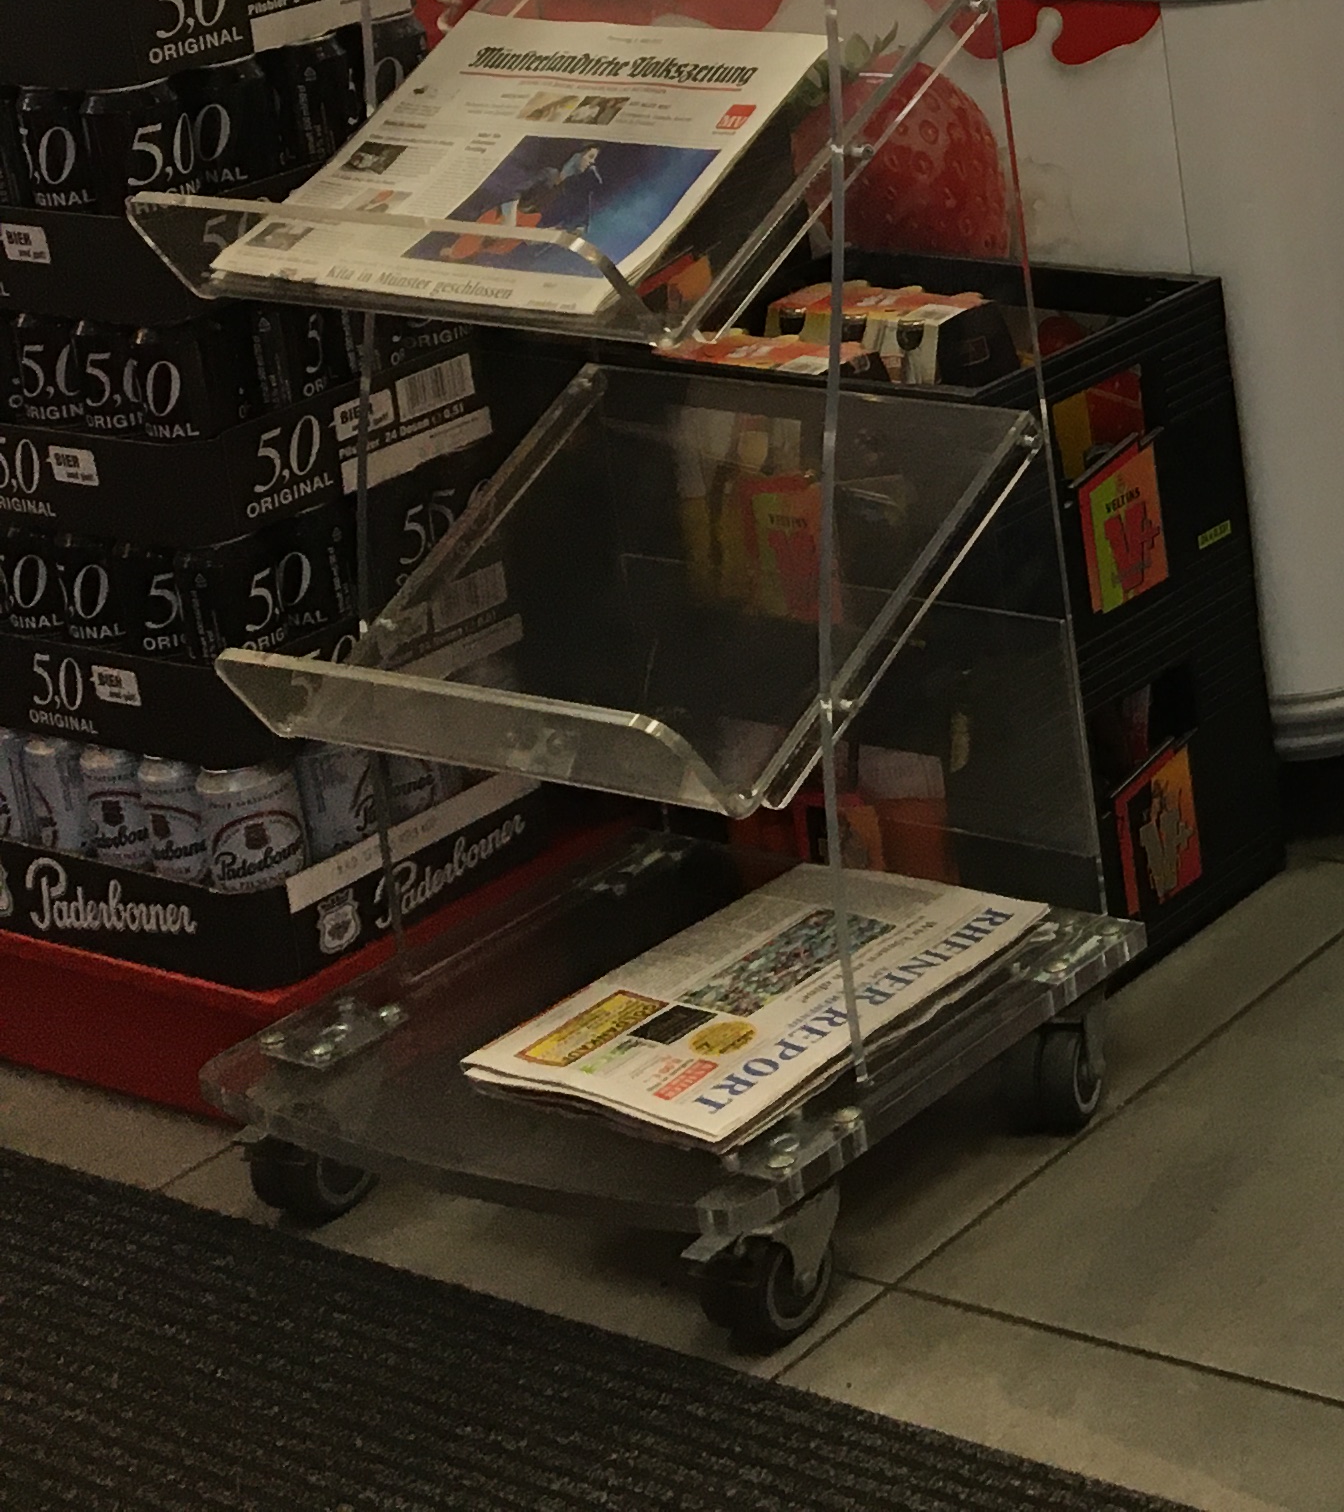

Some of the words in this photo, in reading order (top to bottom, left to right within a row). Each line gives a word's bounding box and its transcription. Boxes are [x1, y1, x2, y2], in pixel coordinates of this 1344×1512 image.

[149, 25, 243, 65] ORIGINAL
[629, 47, 758, 86] Volkszeitung
[721, 114, 746, 128] MV
[376, 268, 427, 289] Münster
[429, 273, 514, 300] geschlossen
[253, 414, 320, 494] 5,0
[246, 473, 334, 519] ORIGINAL
[1105, 486, 1141, 515] VELTINS
[33, 652, 83, 711] 5,0
[29, 709, 99, 735] ORIGINAL
[25, 857, 197, 934] Paderborner
[857, 906, 1015, 1006] RHEINER
[696, 1005, 850, 1115] REPORT
